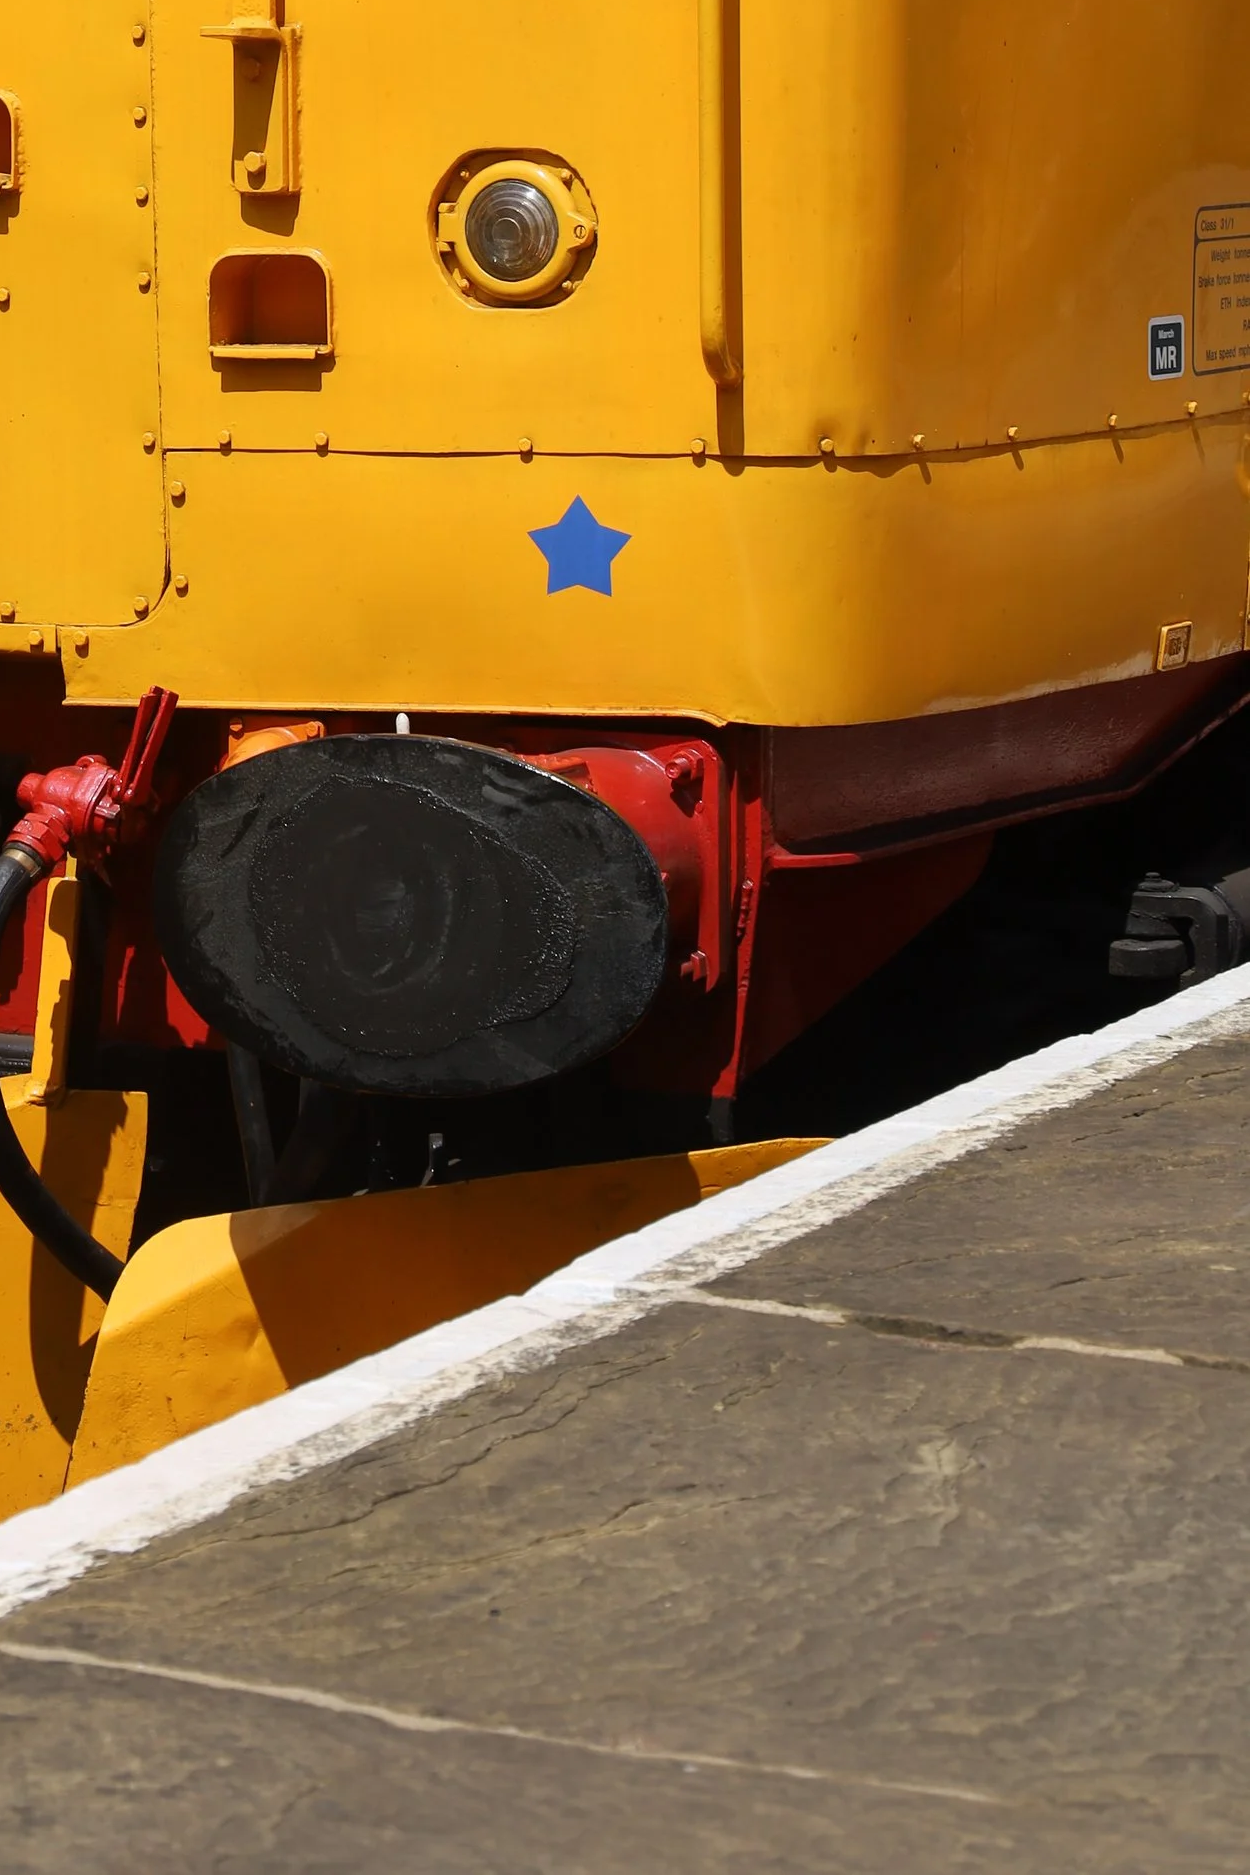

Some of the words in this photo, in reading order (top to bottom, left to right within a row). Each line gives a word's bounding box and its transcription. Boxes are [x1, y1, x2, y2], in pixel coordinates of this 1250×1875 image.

[1200, 219, 1217, 232] Class
[1220, 217, 1235, 231] 31/1
[1211, 248, 1231, 263] Weight
[1234, 247, 1250, 260] tonne
[1198, 276, 1215, 289] Brake
[1216, 273, 1231, 286] force
[1233, 271, 1250, 285] tonne
[1220, 296, 1232, 310] ETH
[1158, 328, 1175, 340] March
[1155, 345, 1177, 370] MR
[1206, 349, 1218, 361] Max
[1218, 345, 1236, 361] speed
